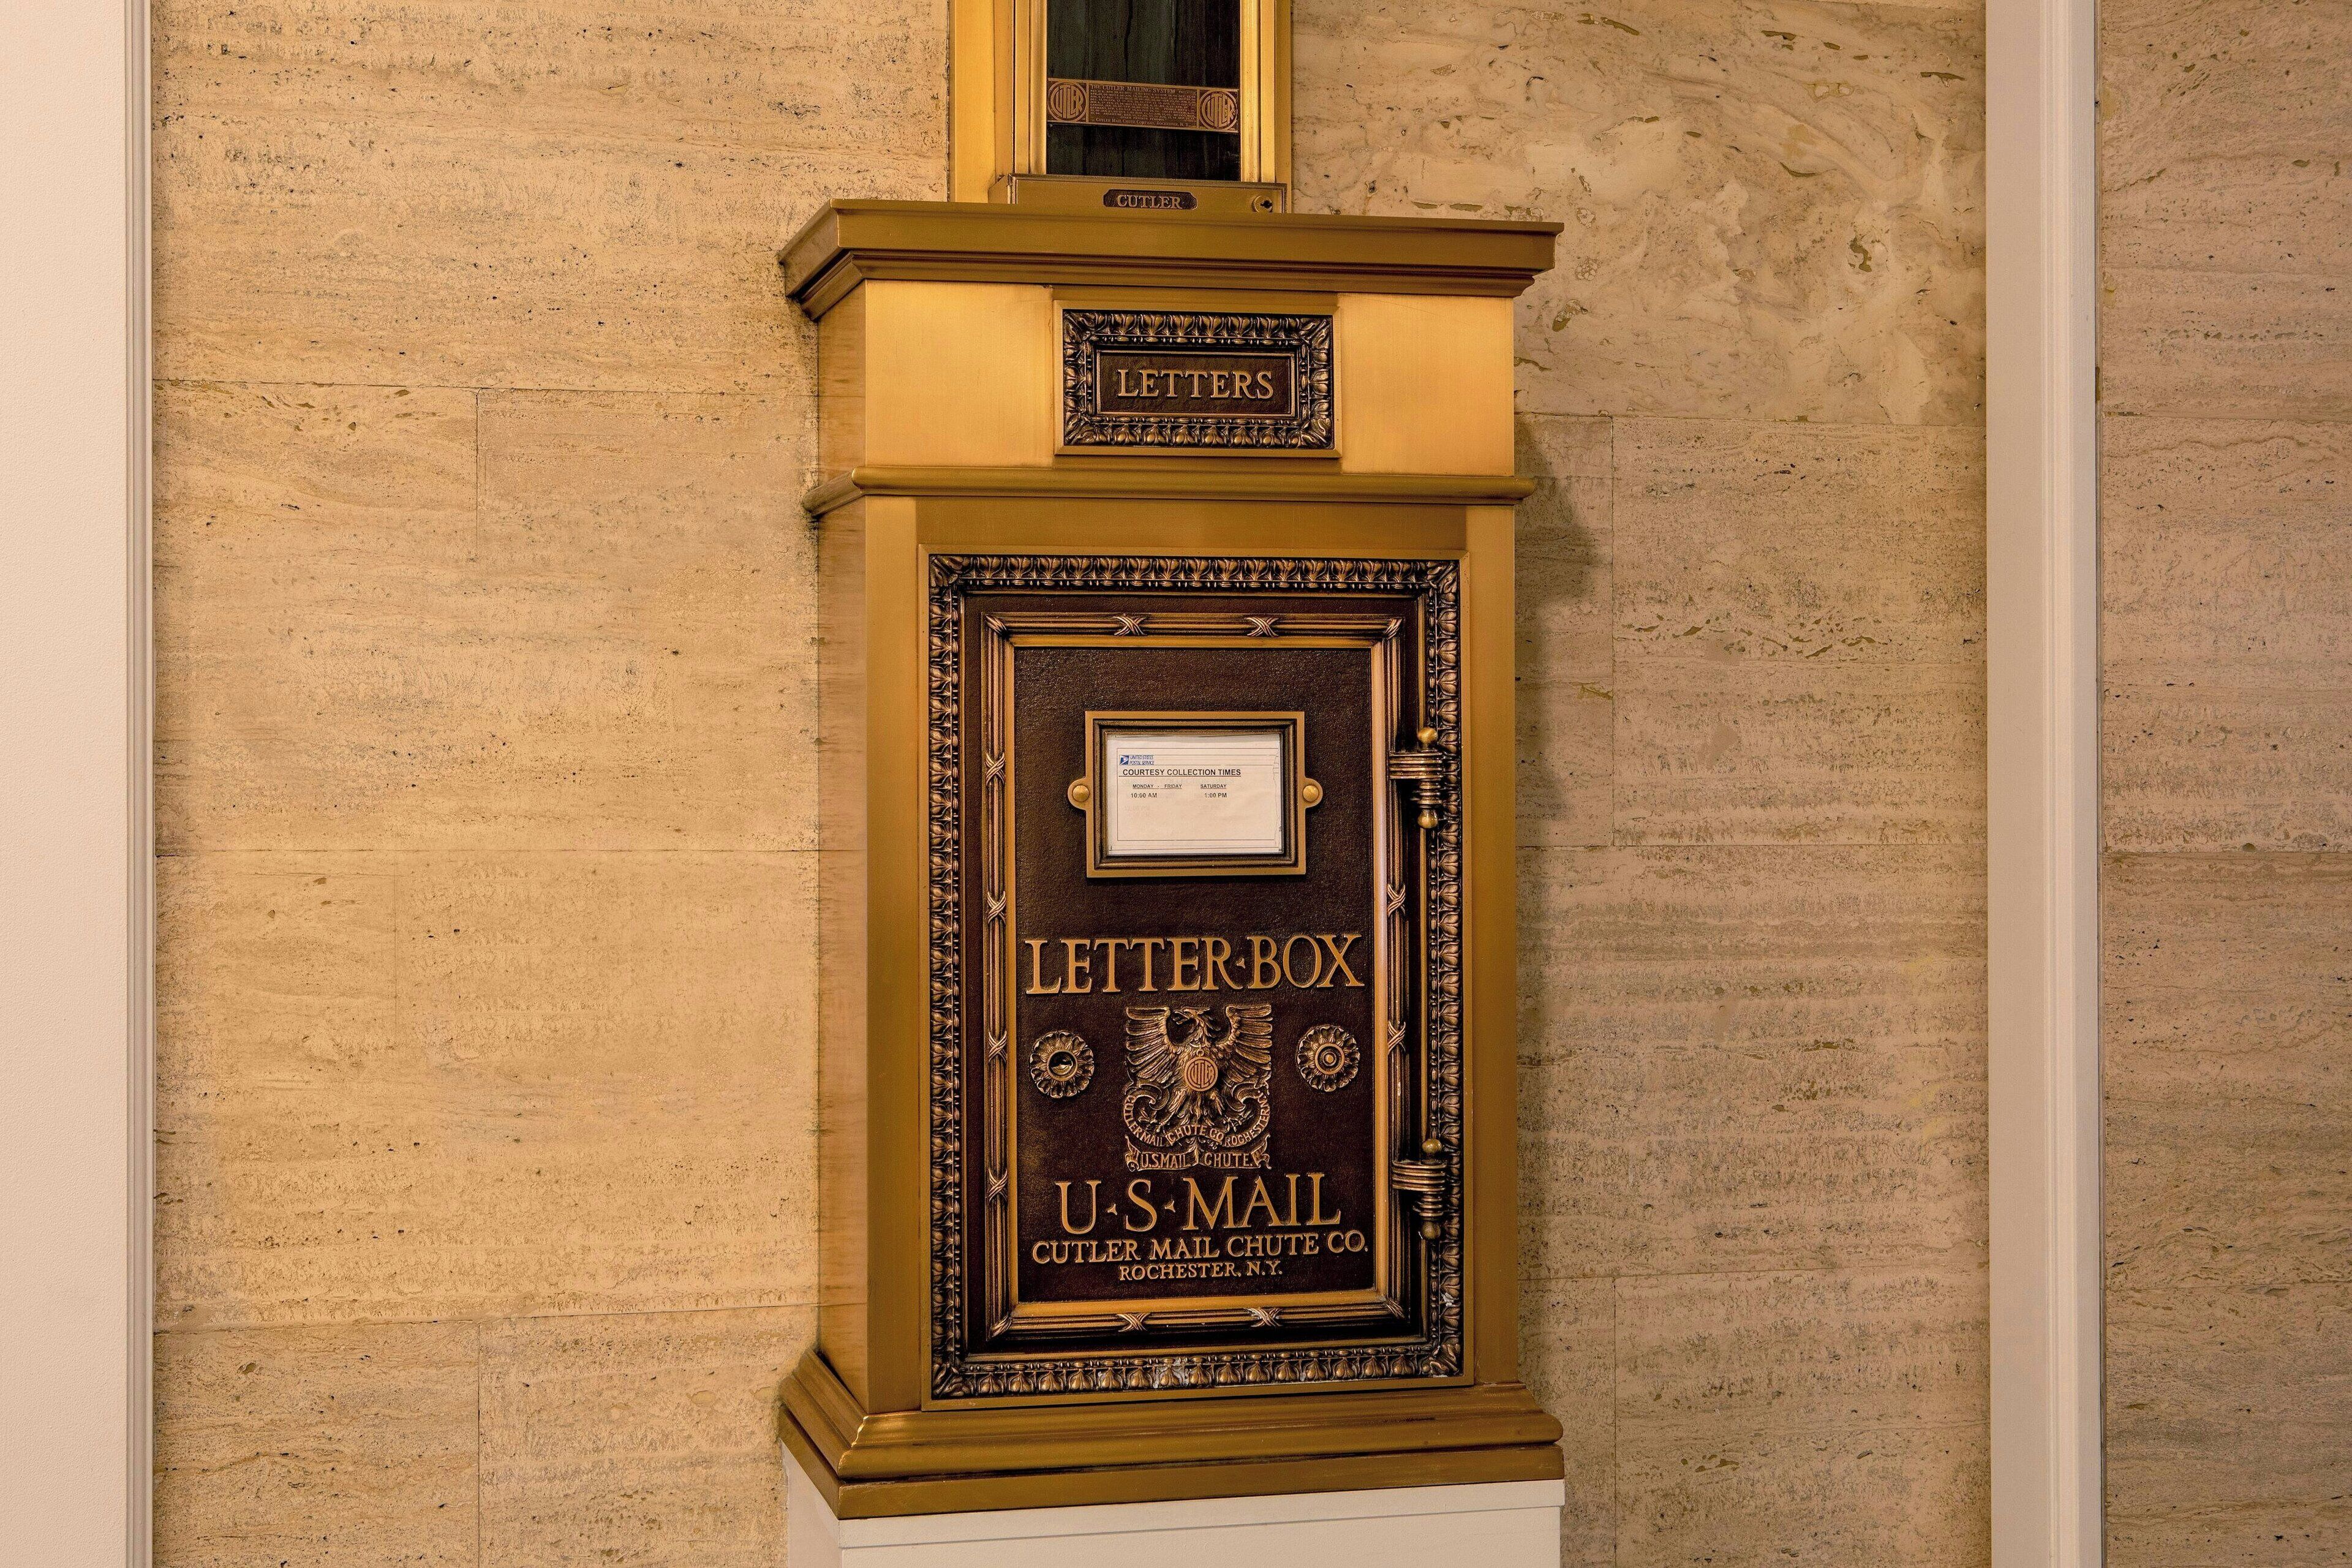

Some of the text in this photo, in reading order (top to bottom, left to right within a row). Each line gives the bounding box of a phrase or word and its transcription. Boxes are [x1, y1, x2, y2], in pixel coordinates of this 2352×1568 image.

[1117, 195, 1183, 209] CUTLER
[1118, 369, 1274, 400] LETTERS
[1166, 1124, 1207, 1145] CHUTE
[1032, 1230, 1368, 1264] CUTLER MAIL CHUTE CO.
